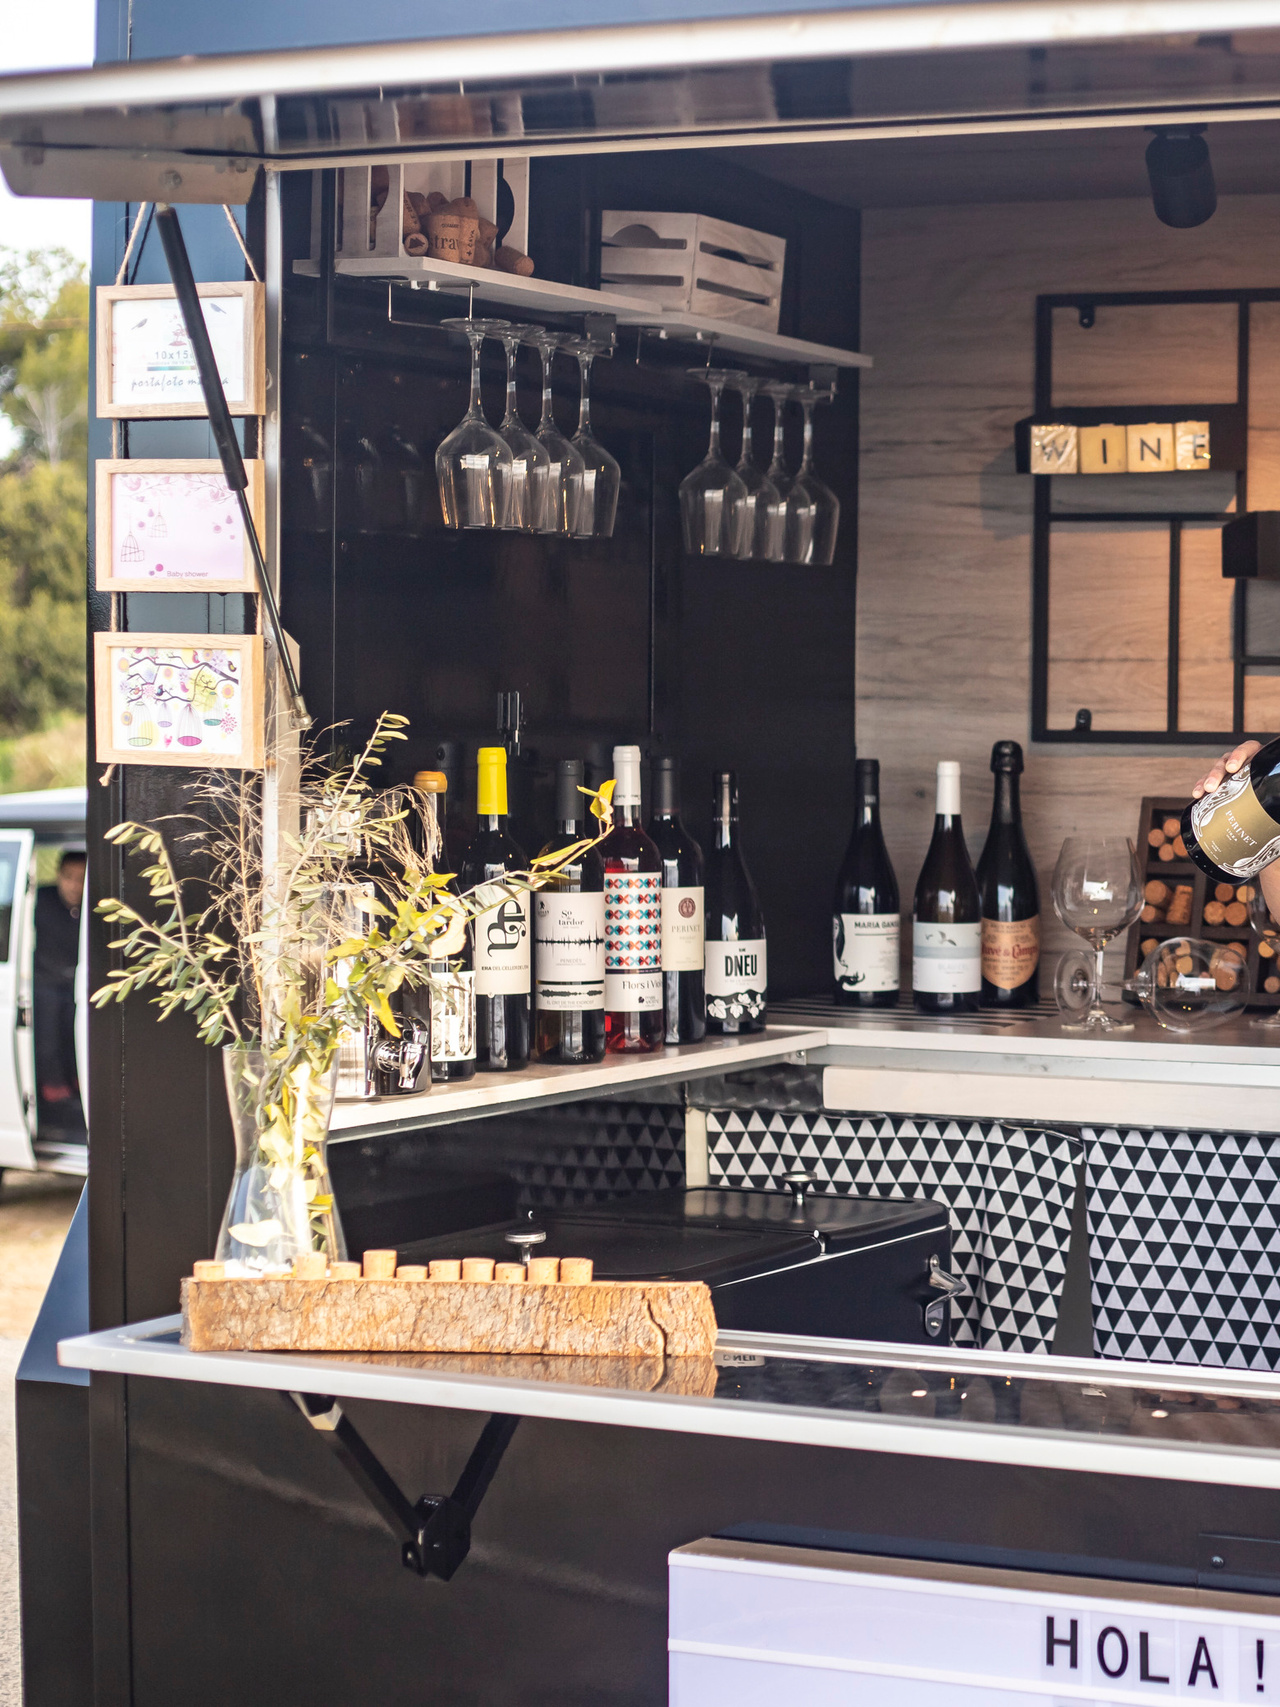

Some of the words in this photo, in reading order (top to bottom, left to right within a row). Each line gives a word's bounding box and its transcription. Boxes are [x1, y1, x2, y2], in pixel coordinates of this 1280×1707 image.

[1042, 434, 1208, 464] WINE
[1225, 810, 1257, 846] PERINET
[558, 918, 584, 926] tardor
[671, 924, 701, 933] PERINET
[725, 954, 757, 976] DNEU
[622, 981, 645, 990] Flors
[1045, 1616, 1218, 1689] HOLA
